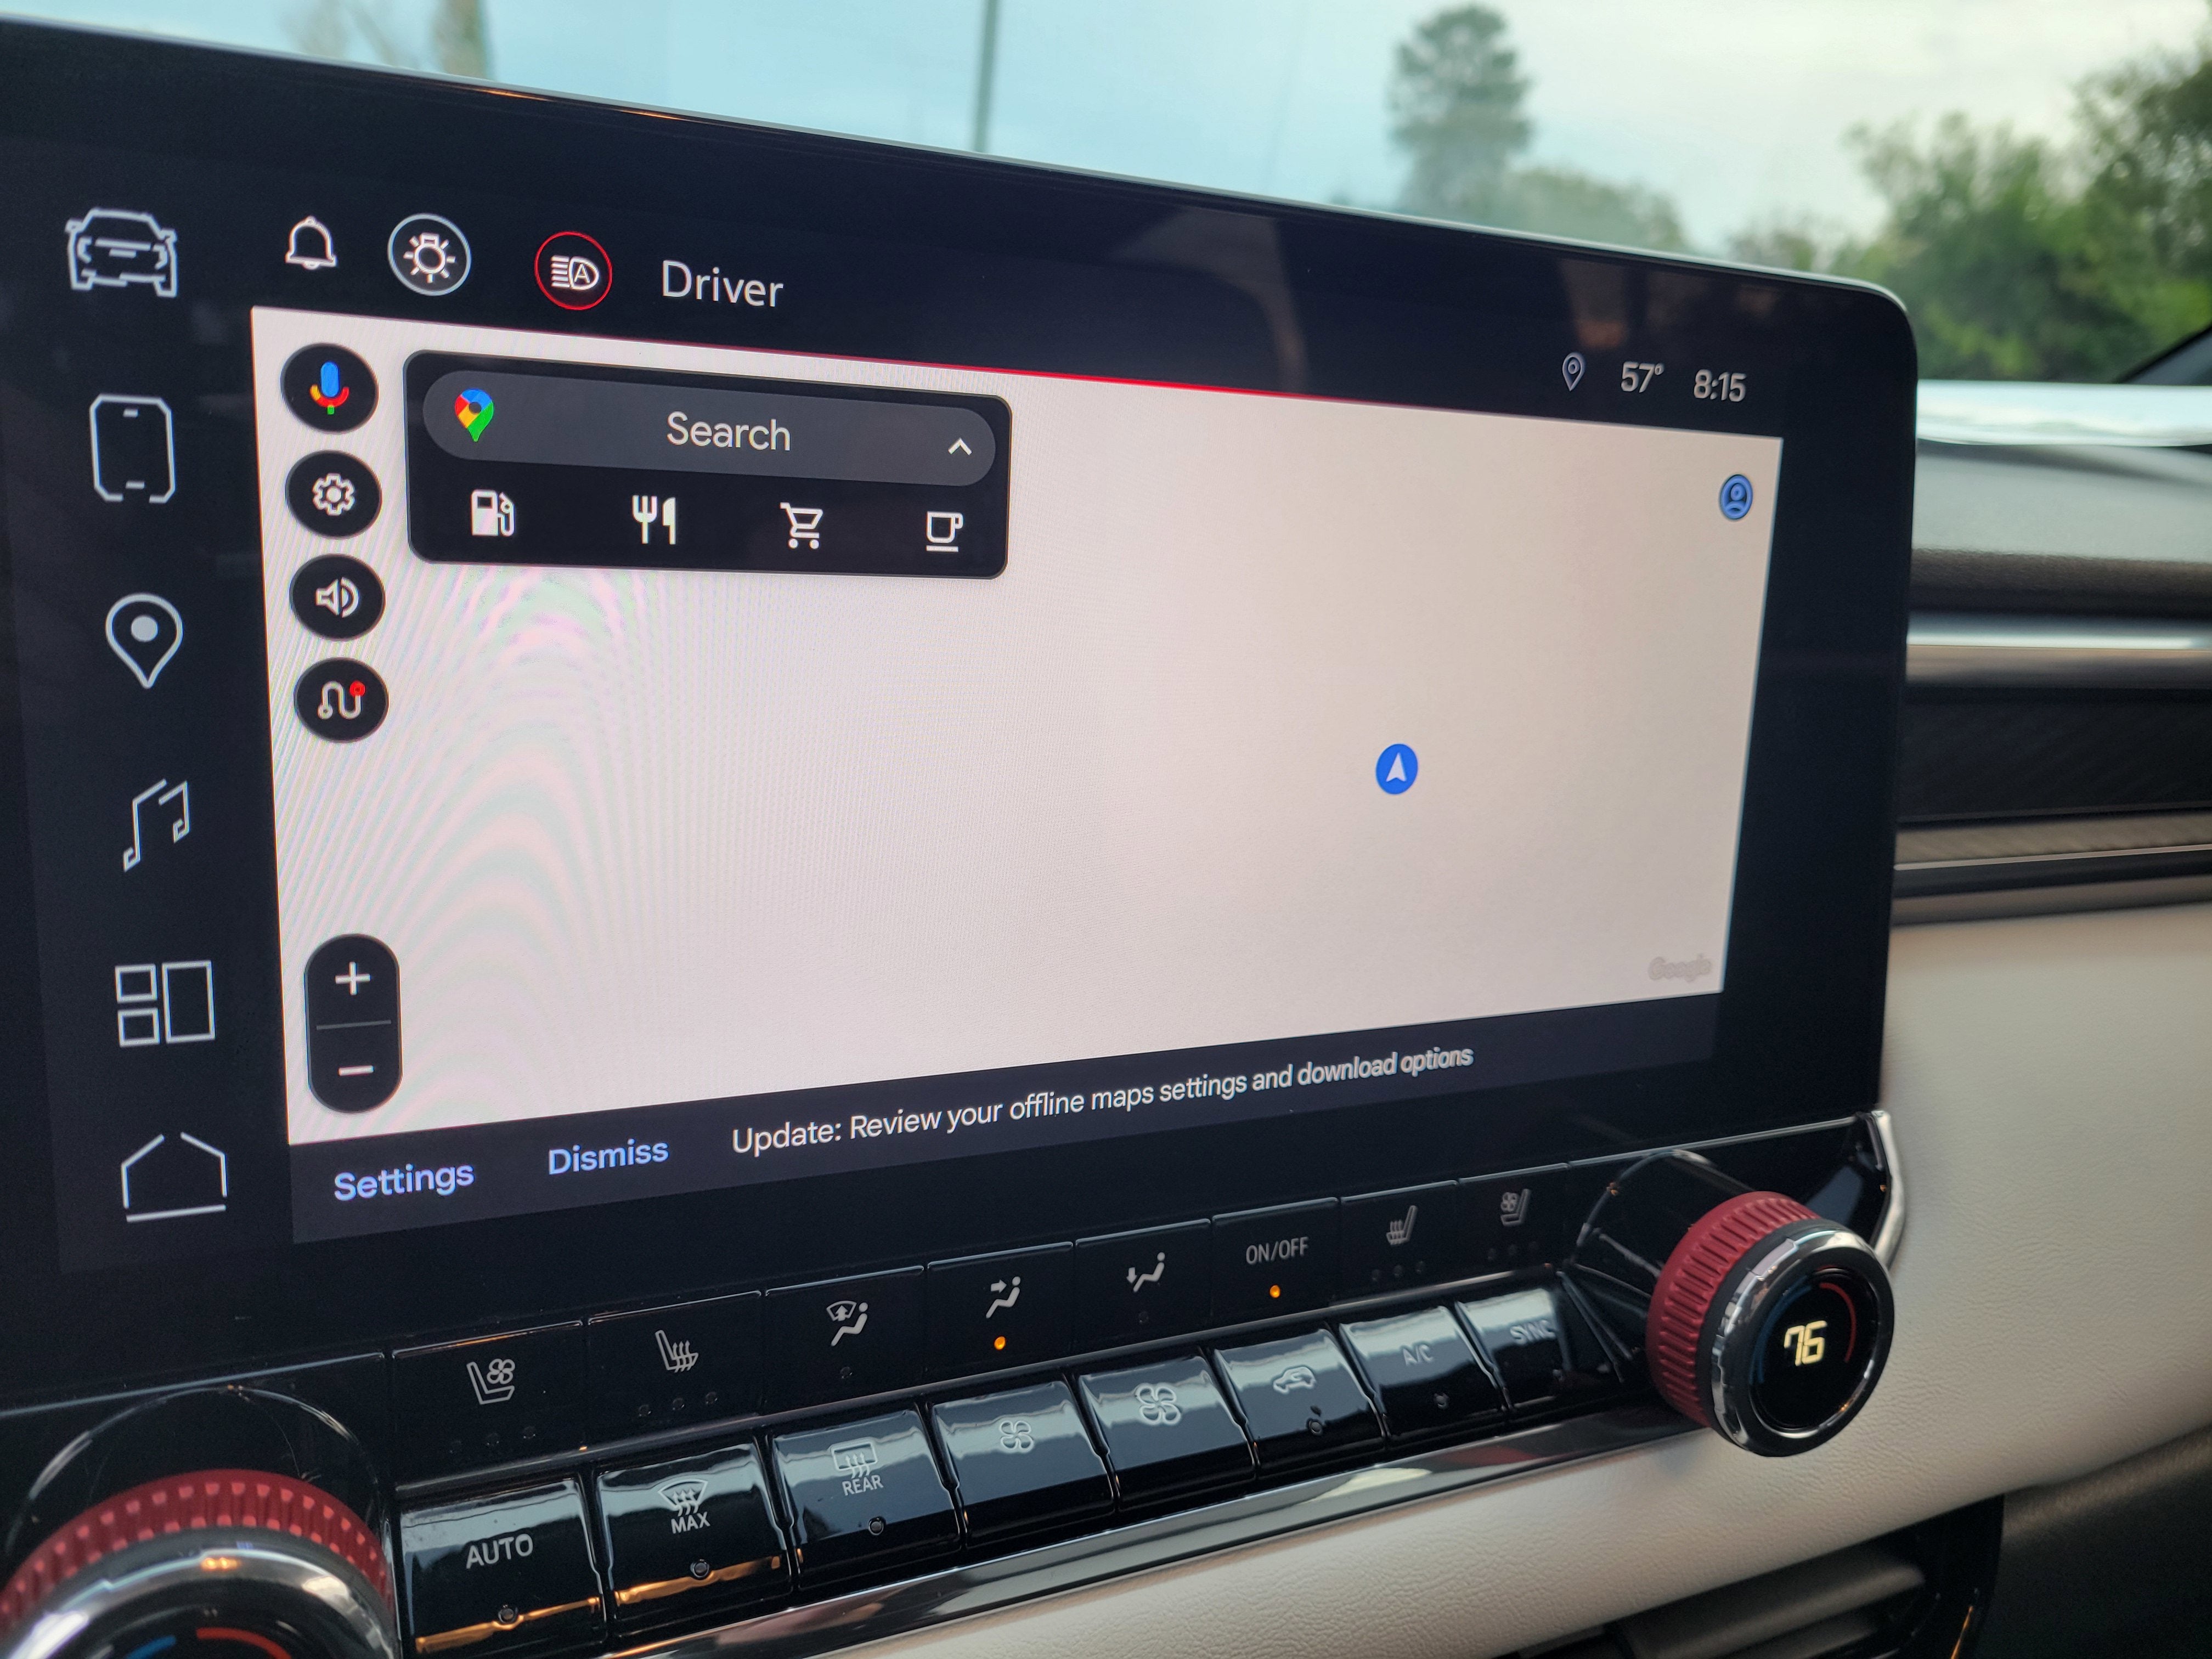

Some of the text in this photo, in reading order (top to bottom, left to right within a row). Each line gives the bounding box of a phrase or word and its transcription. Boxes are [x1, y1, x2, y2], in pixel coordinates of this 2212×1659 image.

[662, 260, 784, 308] Driver
[1620, 361, 1664, 393] 57°
[1693, 369, 1747, 402] 8:15
[667, 411, 791, 452] Search
[732, 1046, 1474, 1158] Update: Review your offline maps settings and download options
[548, 1138, 670, 1175] Dismiss
[334, 1163, 475, 1202] Settings
[1245, 1236, 1309, 1265] ON/OFF
[1403, 1344, 1434, 1365] A/C
[1784, 1319, 1827, 1367] 76
[842, 1474, 883, 1497] REAR
[670, 1510, 710, 1534] MAX
[466, 1533, 534, 1570] AUTO
